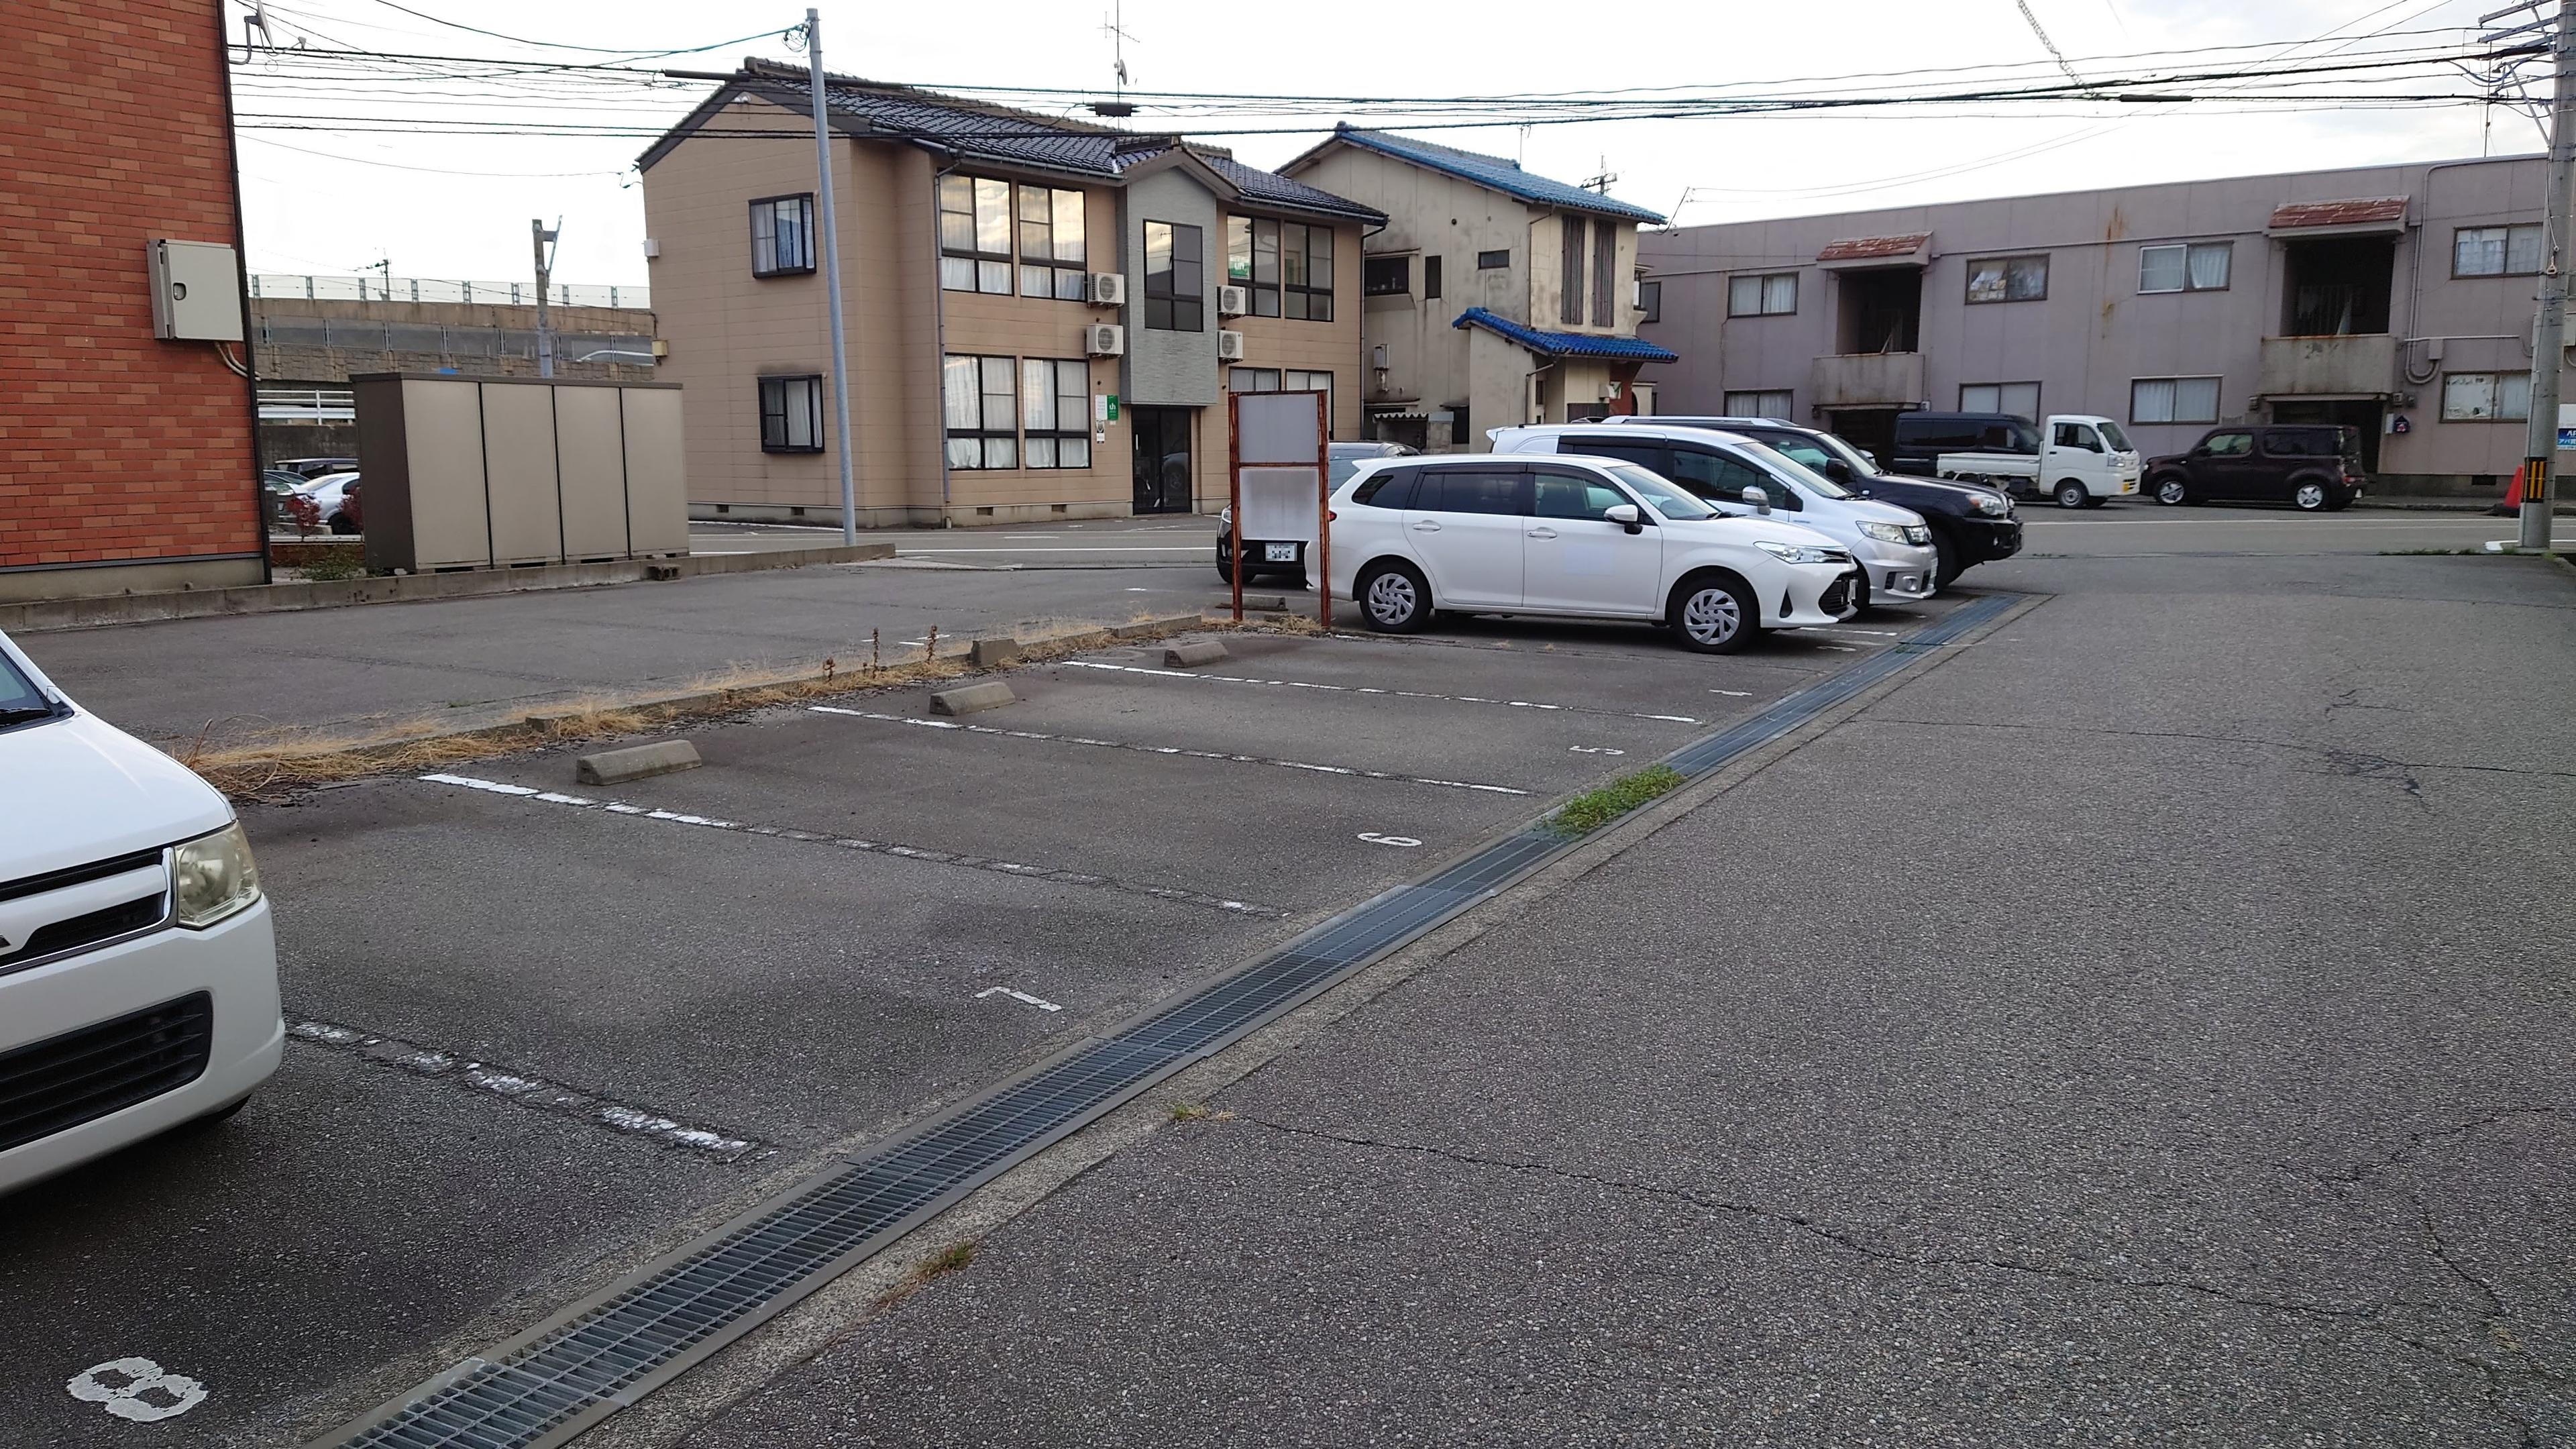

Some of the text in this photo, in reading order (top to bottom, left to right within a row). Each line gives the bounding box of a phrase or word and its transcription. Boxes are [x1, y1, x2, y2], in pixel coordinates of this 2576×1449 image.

[1357, 833, 1422, 847] 6
[973, 986, 1062, 1012] 7
[67, 1356, 209, 1421] 8
